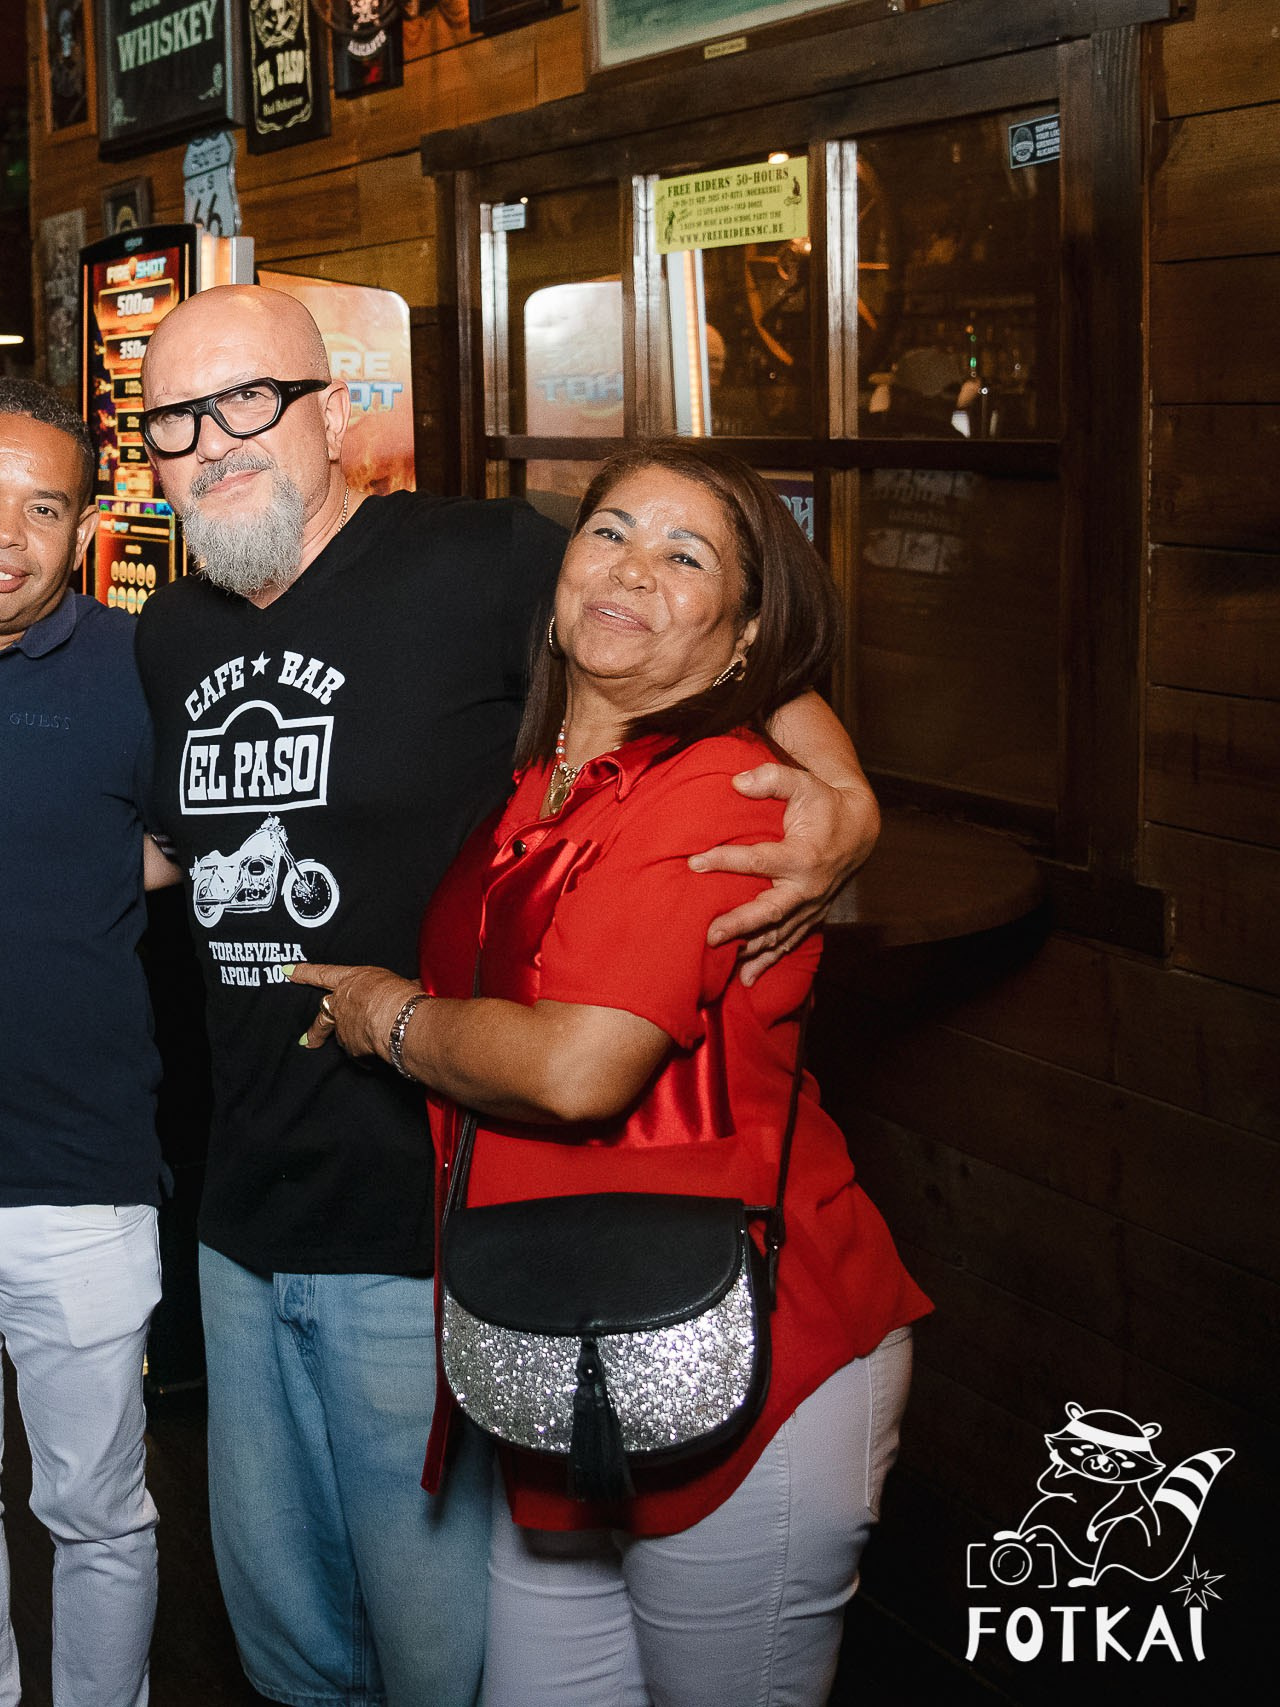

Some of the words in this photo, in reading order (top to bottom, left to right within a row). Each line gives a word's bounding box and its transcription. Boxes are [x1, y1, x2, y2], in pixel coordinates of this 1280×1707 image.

[117, 0, 217, 72] WHISKEY
[257, 60, 274, 96] EL
[276, 49, 305, 86] PASO
[668, 184, 690, 198] FREE
[135, 256, 167, 279] SHOT
[330, 351, 392, 379] RE
[347, 381, 403, 411] OT
[184, 656, 245, 722] CAFE
[277, 650, 346, 705] BAR
[9, 712, 71, 730] GUESS
[187, 744, 227, 801] EL
[232, 734, 319, 798] PASO
[208, 941, 308, 963] TORREVIEJA
[220, 965, 261, 987] APOLO
[263, 964, 291, 984] 10
